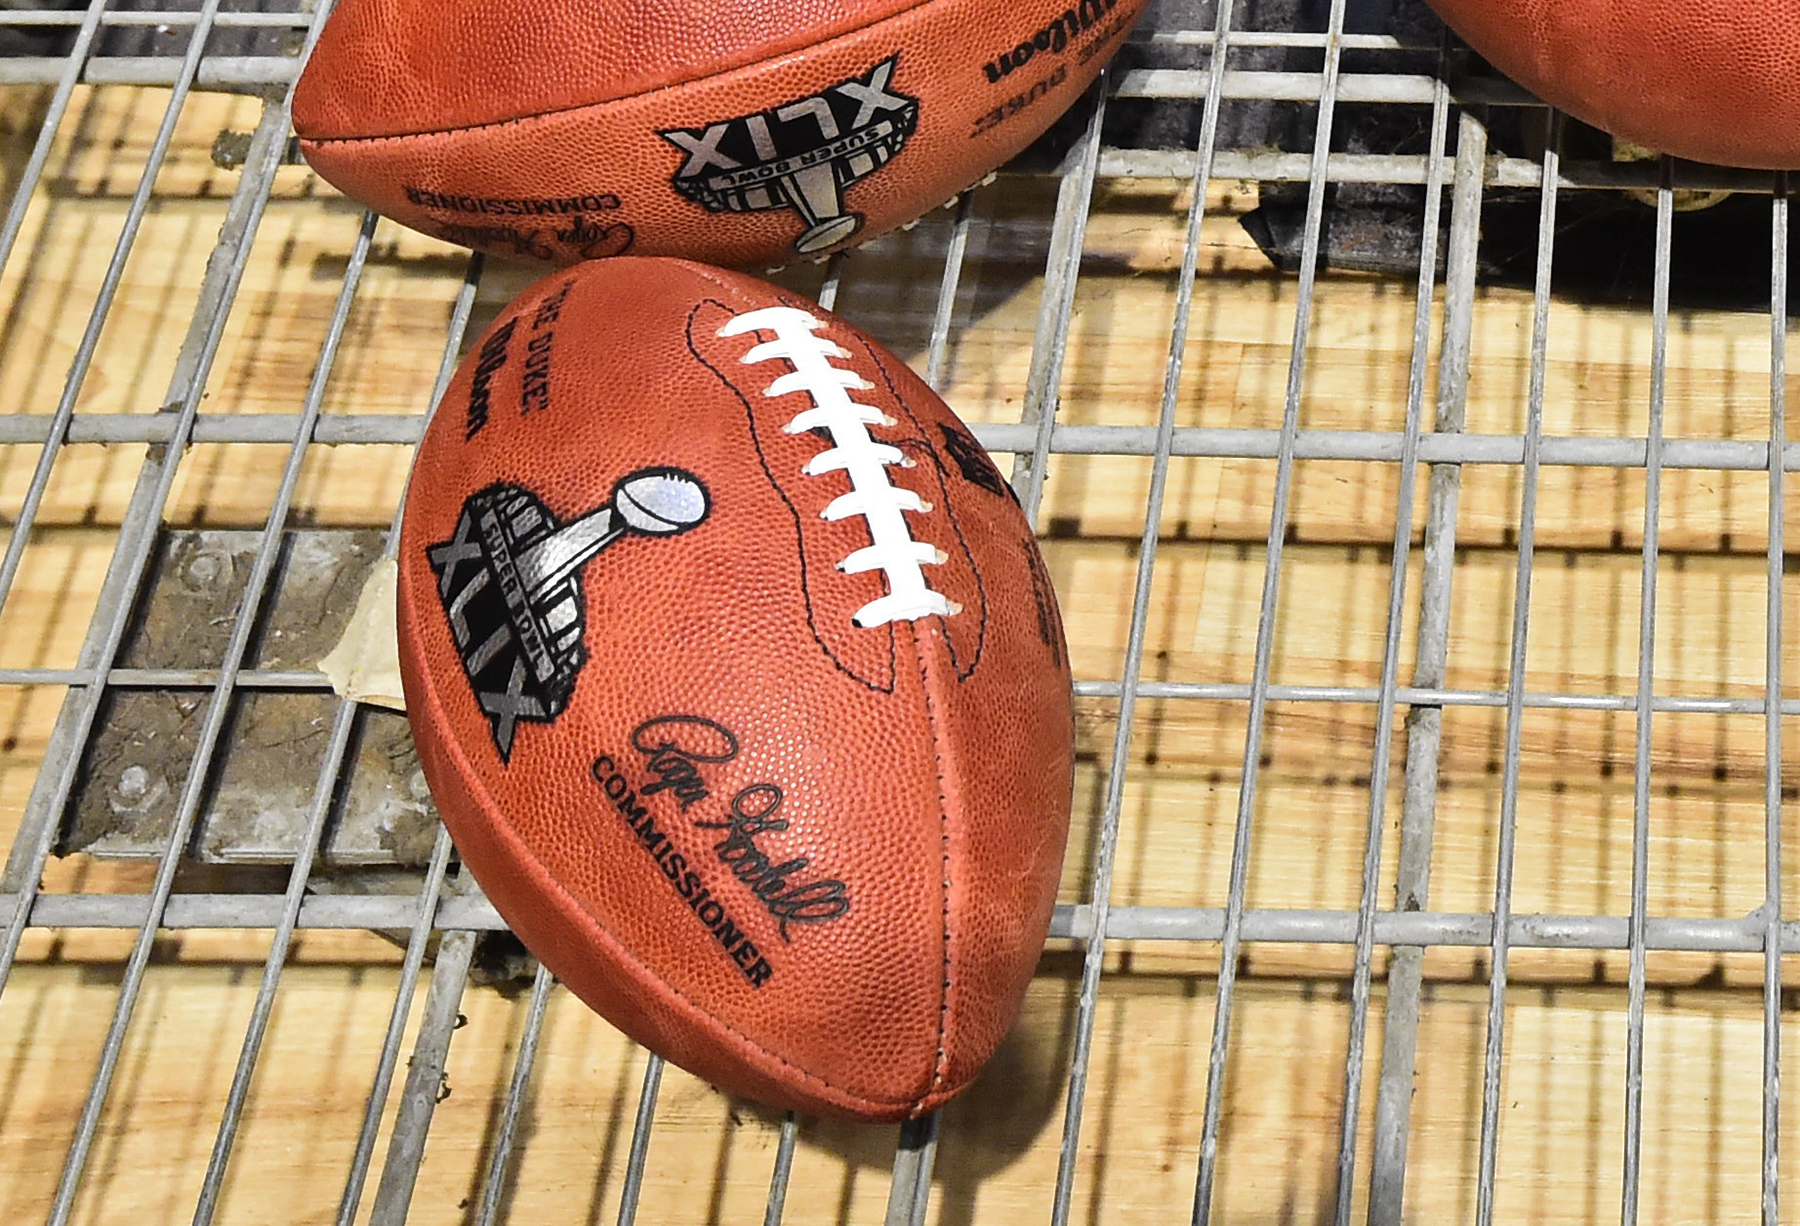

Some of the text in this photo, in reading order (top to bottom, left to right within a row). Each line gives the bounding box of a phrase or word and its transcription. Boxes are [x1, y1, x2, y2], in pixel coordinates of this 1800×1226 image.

[663, 60, 911, 180] XLIX
[724, 126, 881, 185] SUPER BOWL
[404, 187, 622, 215] COMMISSIONER
[465, 314, 520, 443] Wilson
[490, 522, 520, 595] SUPER
[430, 510, 549, 756] XLIX
[592, 754, 775, 989] COMMISSIONER
